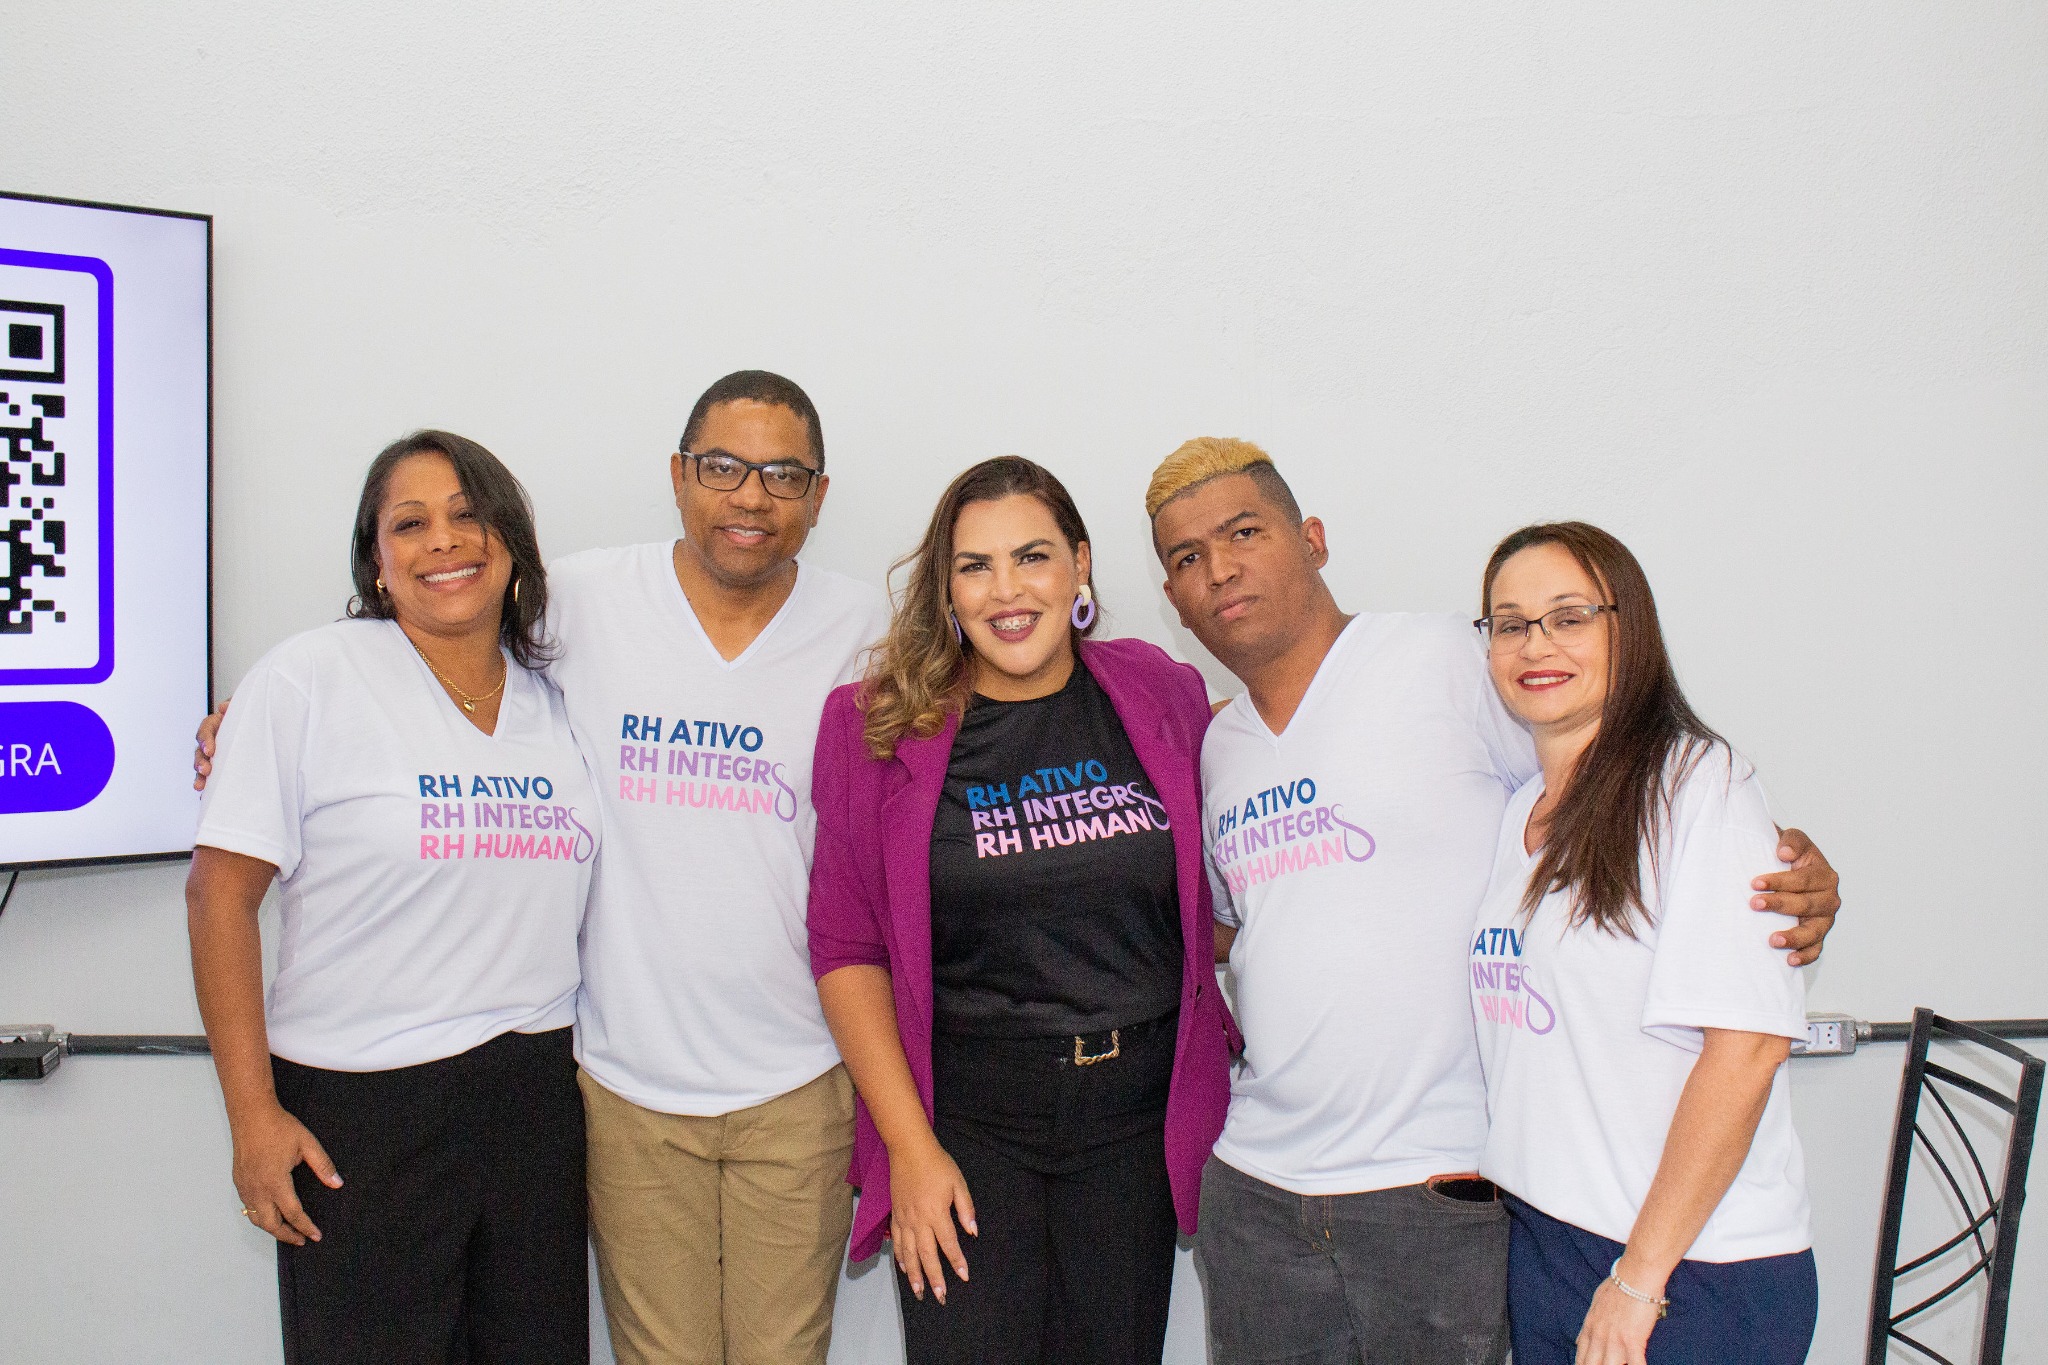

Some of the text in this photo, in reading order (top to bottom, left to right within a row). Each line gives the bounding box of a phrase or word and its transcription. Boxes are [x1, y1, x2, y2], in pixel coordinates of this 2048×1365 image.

[621, 714, 763, 752] RH ATIVO
[0, 742, 62, 777] RA
[620, 745, 658, 773] RH
[418, 774, 553, 800] RH ATIVO
[619, 775, 656, 804] RH
[966, 759, 1108, 809] RH ATIVO
[420, 803, 465, 829] RH
[972, 806, 1017, 831] RH
[1218, 777, 1316, 839] RH ATIVO
[420, 834, 465, 860] RH
[976, 829, 1023, 859] RH
[1215, 834, 1239, 867] RH
